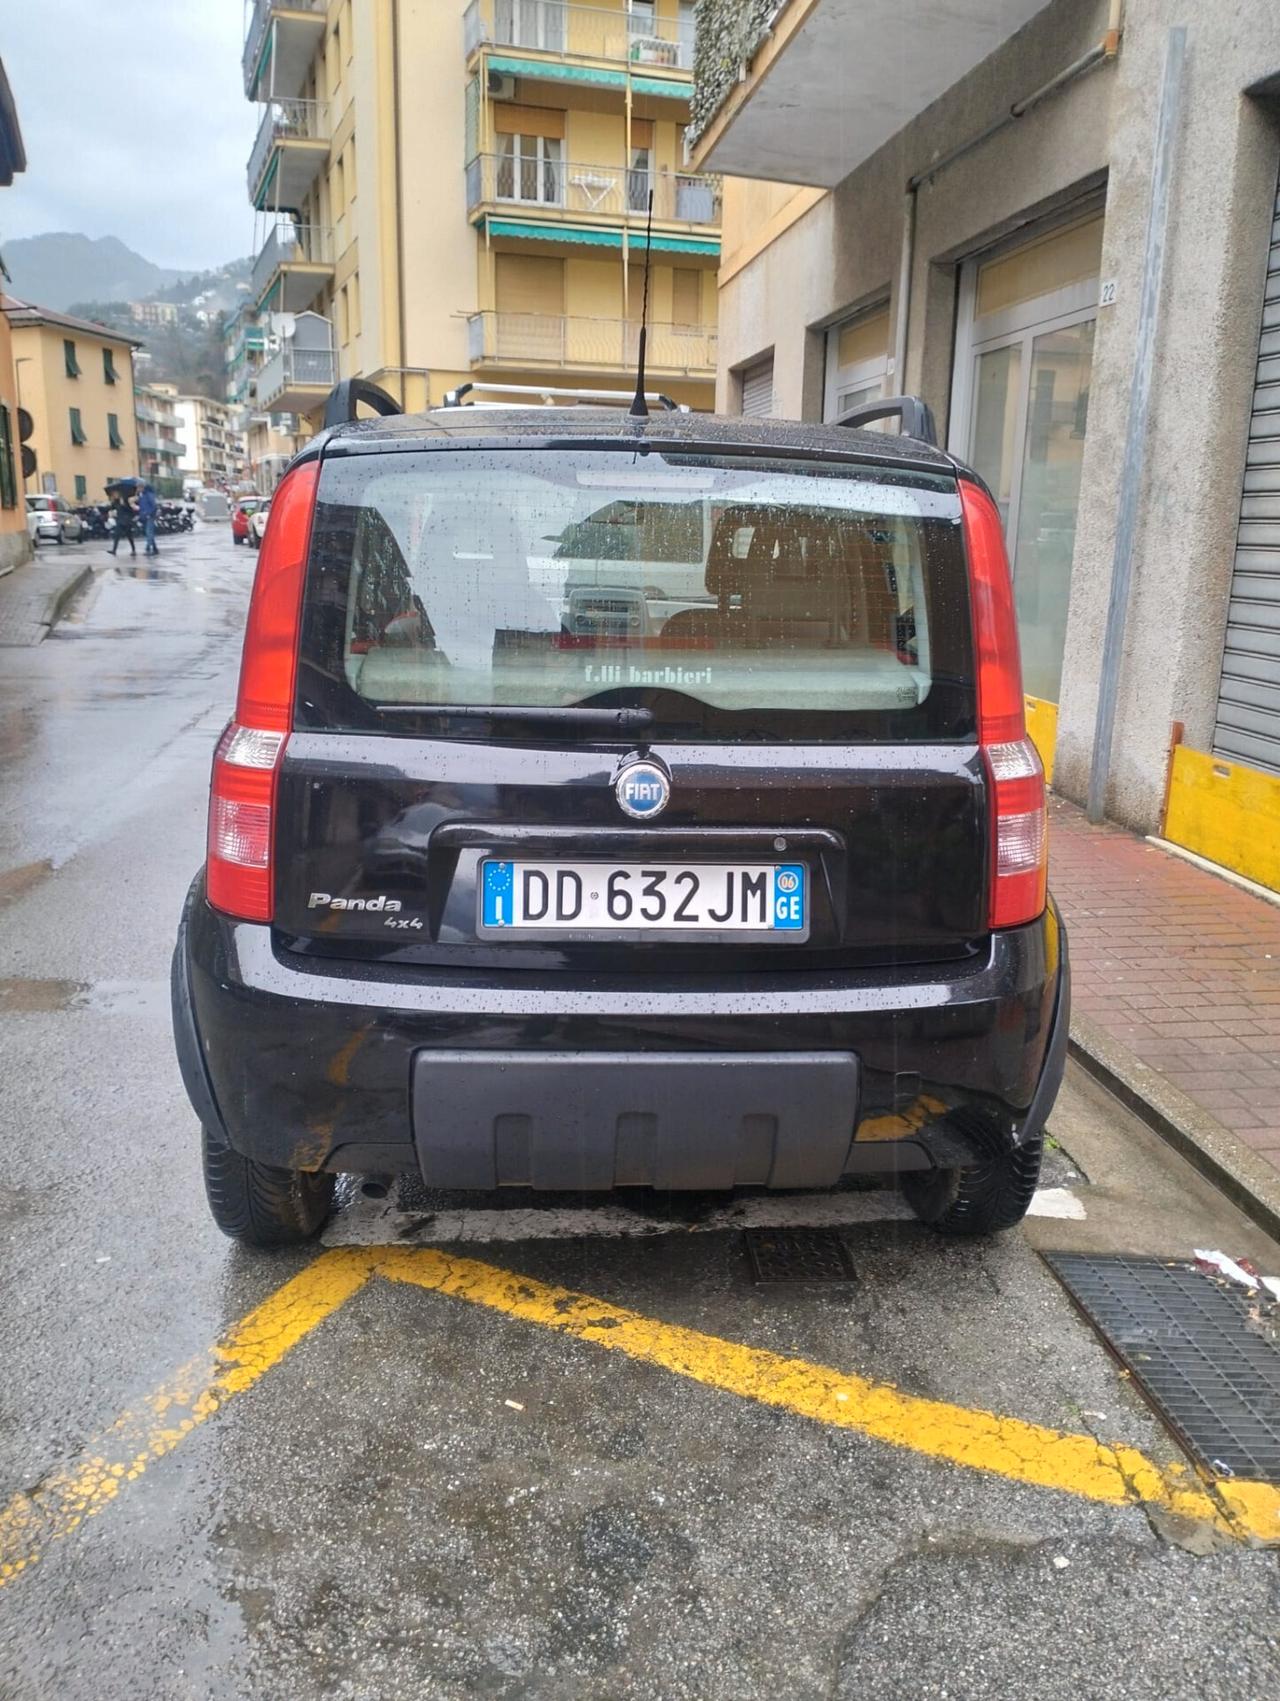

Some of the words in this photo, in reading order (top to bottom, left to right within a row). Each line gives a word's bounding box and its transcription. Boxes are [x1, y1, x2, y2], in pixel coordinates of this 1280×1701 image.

[1103, 283, 1115, 303] 22
[629, 666, 712, 684] barbieri
[625, 783, 660, 800] FIAT
[781, 875, 795, 889] 06
[307, 892, 402, 912] Panda
[522, 870, 583, 921] DD
[776, 896, 800, 920] GE
[384, 916, 423, 929] 4x4
